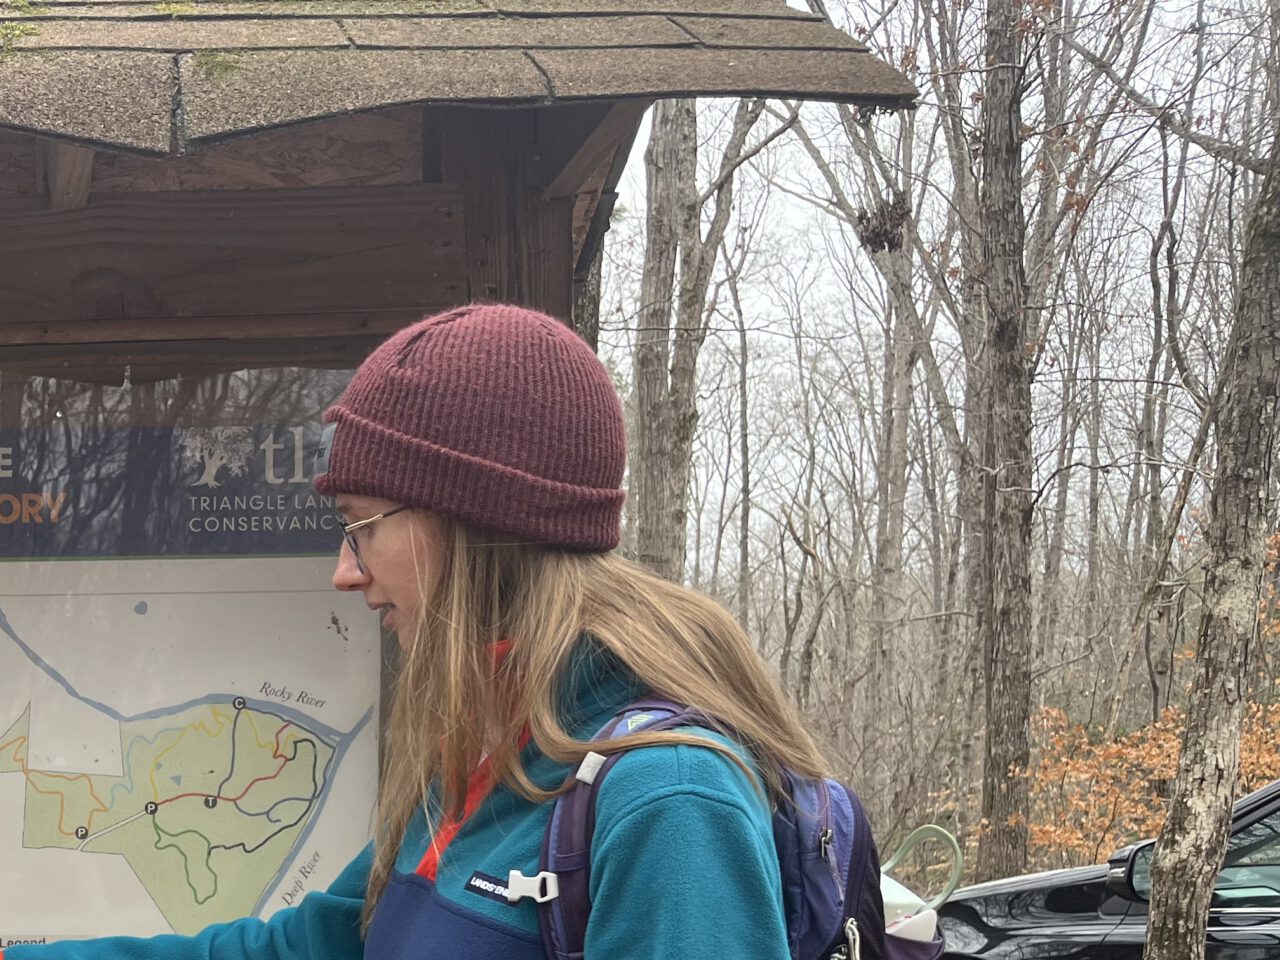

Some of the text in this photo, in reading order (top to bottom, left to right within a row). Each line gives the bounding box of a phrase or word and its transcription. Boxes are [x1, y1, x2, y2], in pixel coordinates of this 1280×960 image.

[190, 495, 337, 512] TRIANGLE LAN
[258, 682, 326, 708] Rocky River
[282, 850, 320, 906] Deep River
